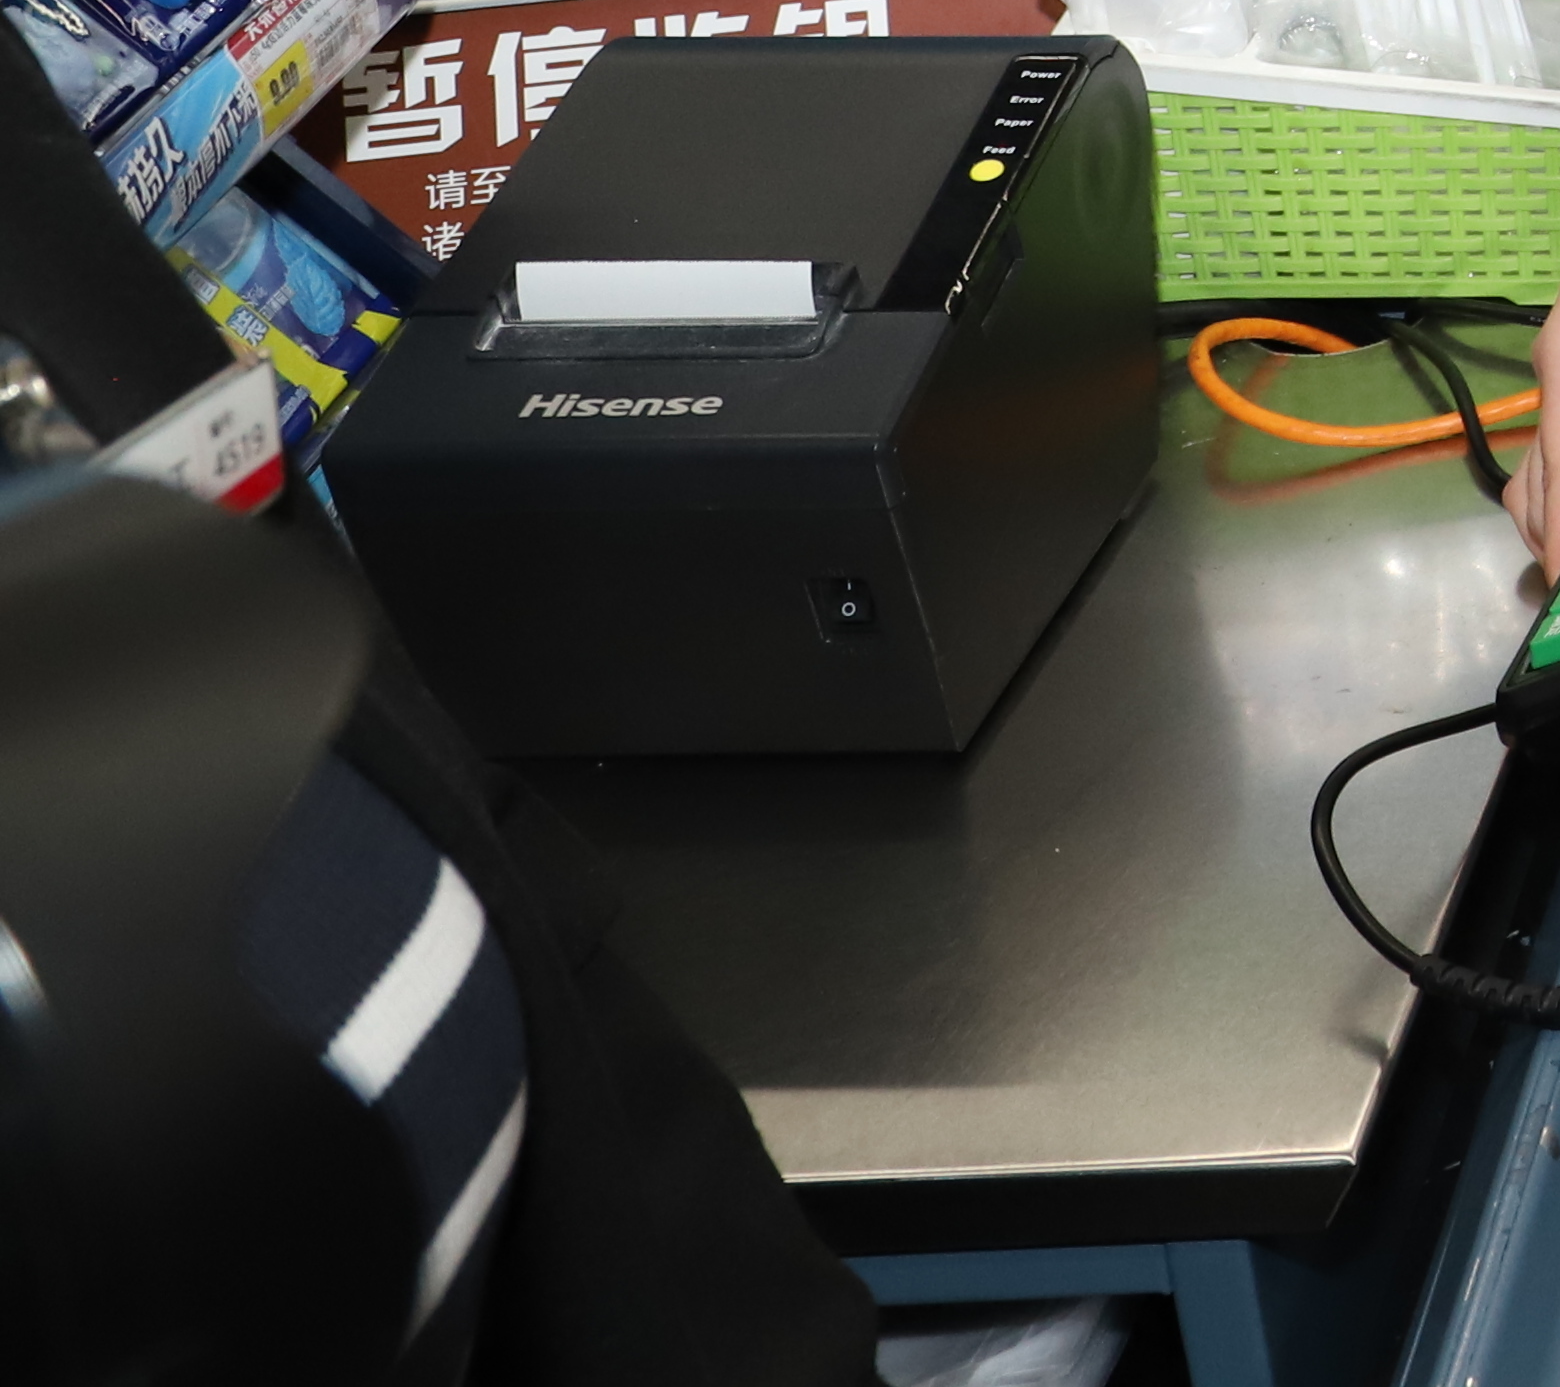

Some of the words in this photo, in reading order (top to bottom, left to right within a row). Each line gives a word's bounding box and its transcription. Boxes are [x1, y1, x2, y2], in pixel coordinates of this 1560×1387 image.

[1020, 70, 1062, 79] Power
[1009, 95, 1044, 104] Error
[994, 118, 1034, 128] Paper
[982, 145, 1016, 155] Feed
[517, 391, 724, 421] Hisense
